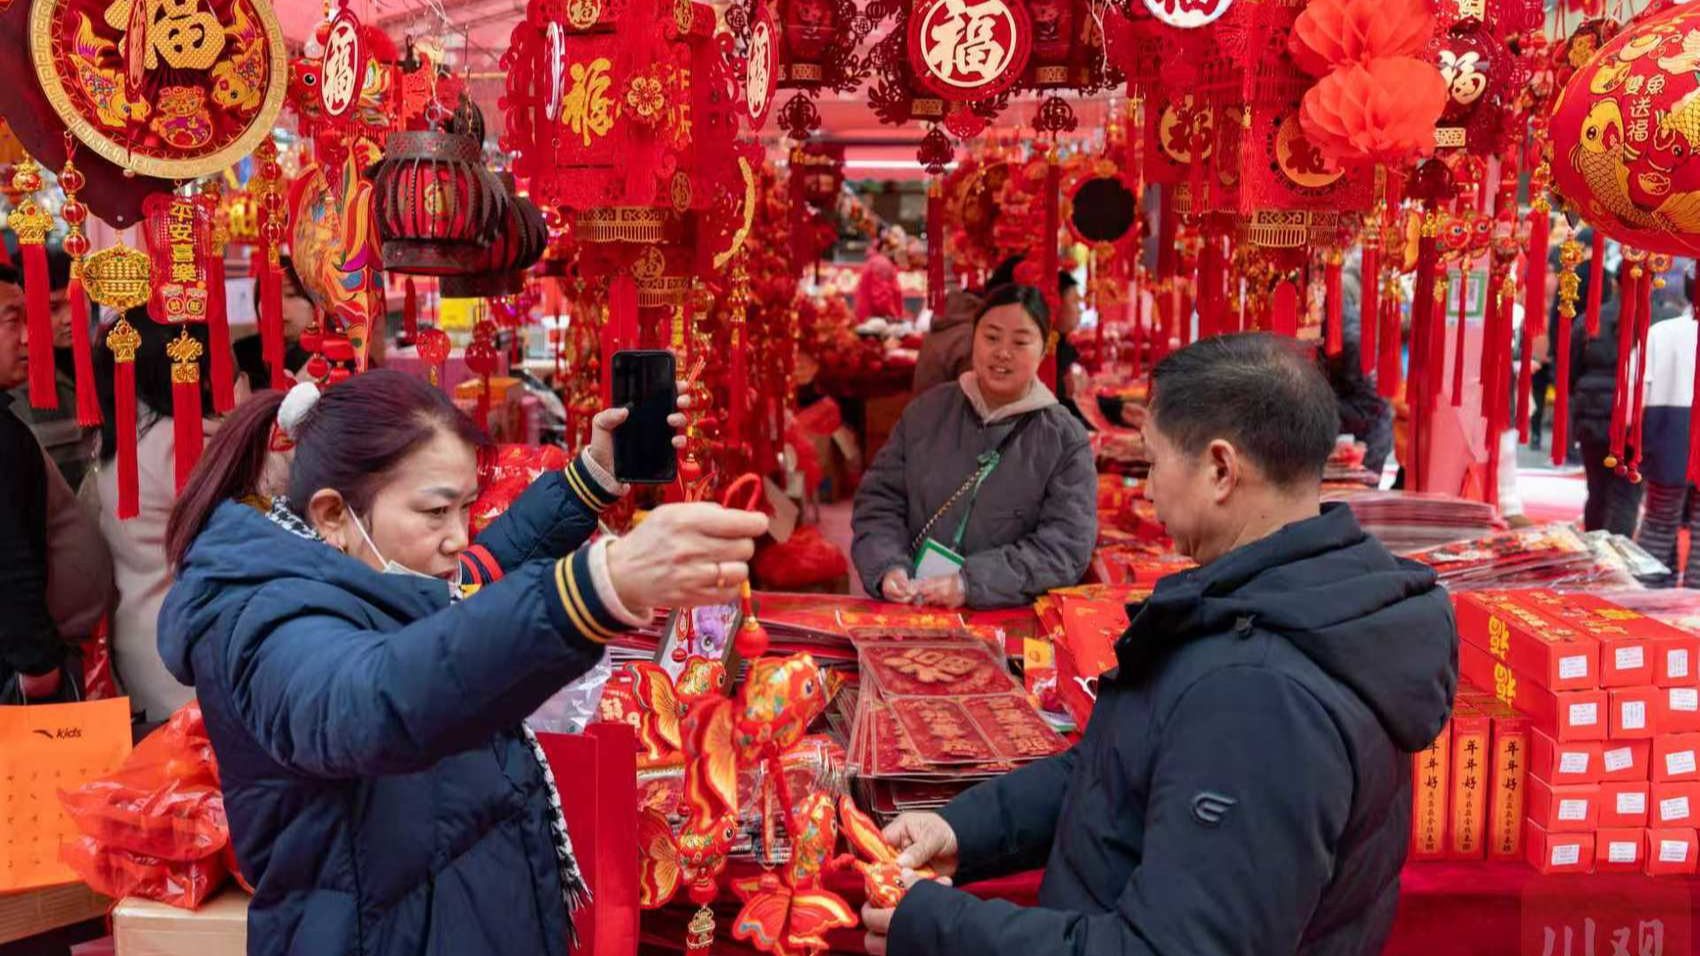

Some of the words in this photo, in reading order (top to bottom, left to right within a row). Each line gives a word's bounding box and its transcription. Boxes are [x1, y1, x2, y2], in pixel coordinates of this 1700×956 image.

[929, 0, 1005, 80] 福
[323, 25, 356, 112] 福
[1438, 50, 1486, 104] 福
[562, 58, 614, 147] 福
[1627, 96, 1651, 142] 送福
[56, 727, 82, 740] kids
[1462, 739, 1479, 790] 年年好
[1502, 740, 1520, 791] 年年好
